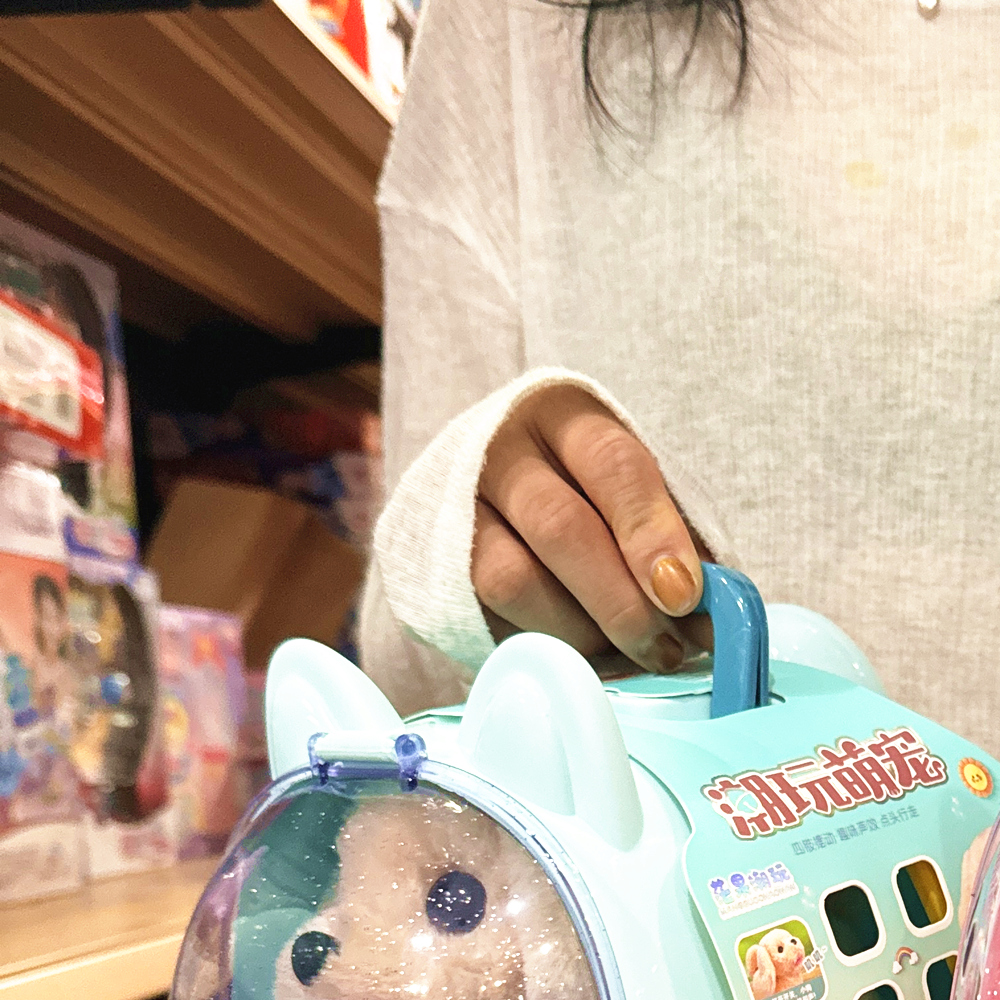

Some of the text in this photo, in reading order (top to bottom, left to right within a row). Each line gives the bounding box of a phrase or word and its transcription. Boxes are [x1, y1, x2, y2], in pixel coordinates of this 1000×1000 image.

[706, 729, 945, 838] 潮玩萌宠
[837, 818, 879, 842] 趣味声效
[880, 804, 920, 829] 点头行走
